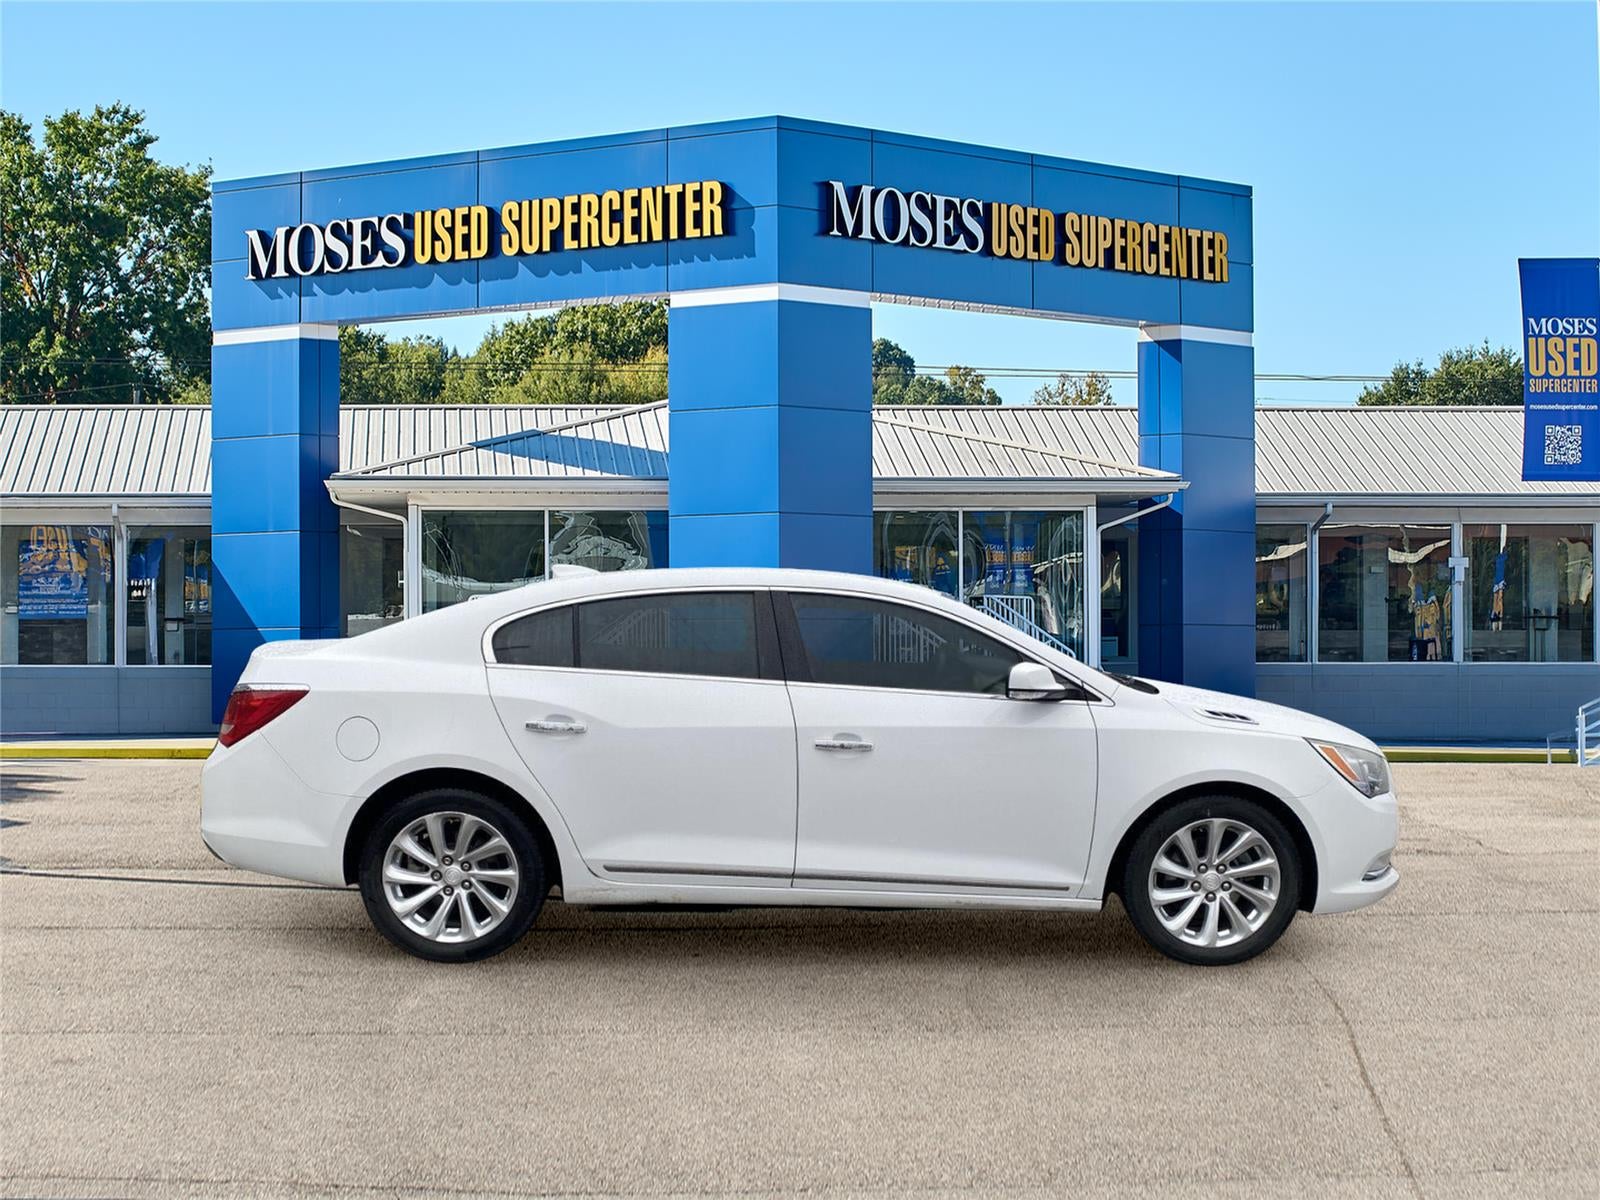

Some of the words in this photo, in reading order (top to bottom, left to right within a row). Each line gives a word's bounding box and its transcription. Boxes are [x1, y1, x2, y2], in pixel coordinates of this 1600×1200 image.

[245, 213, 408, 281] MOSES
[413, 206, 489, 265] USED
[500, 180, 725, 256] SUPERCENTER
[829, 181, 985, 254] MOSES
[990, 202, 1055, 261] USED
[1064, 212, 1229, 283] SUPERCENTER
[1527, 317, 1597, 336] MOSES
[1528, 338, 1598, 377] USED
[1529, 379, 1598, 393] SUPERCENTER
[1529, 403, 1598, 412] mosesusedsupercenter.com
